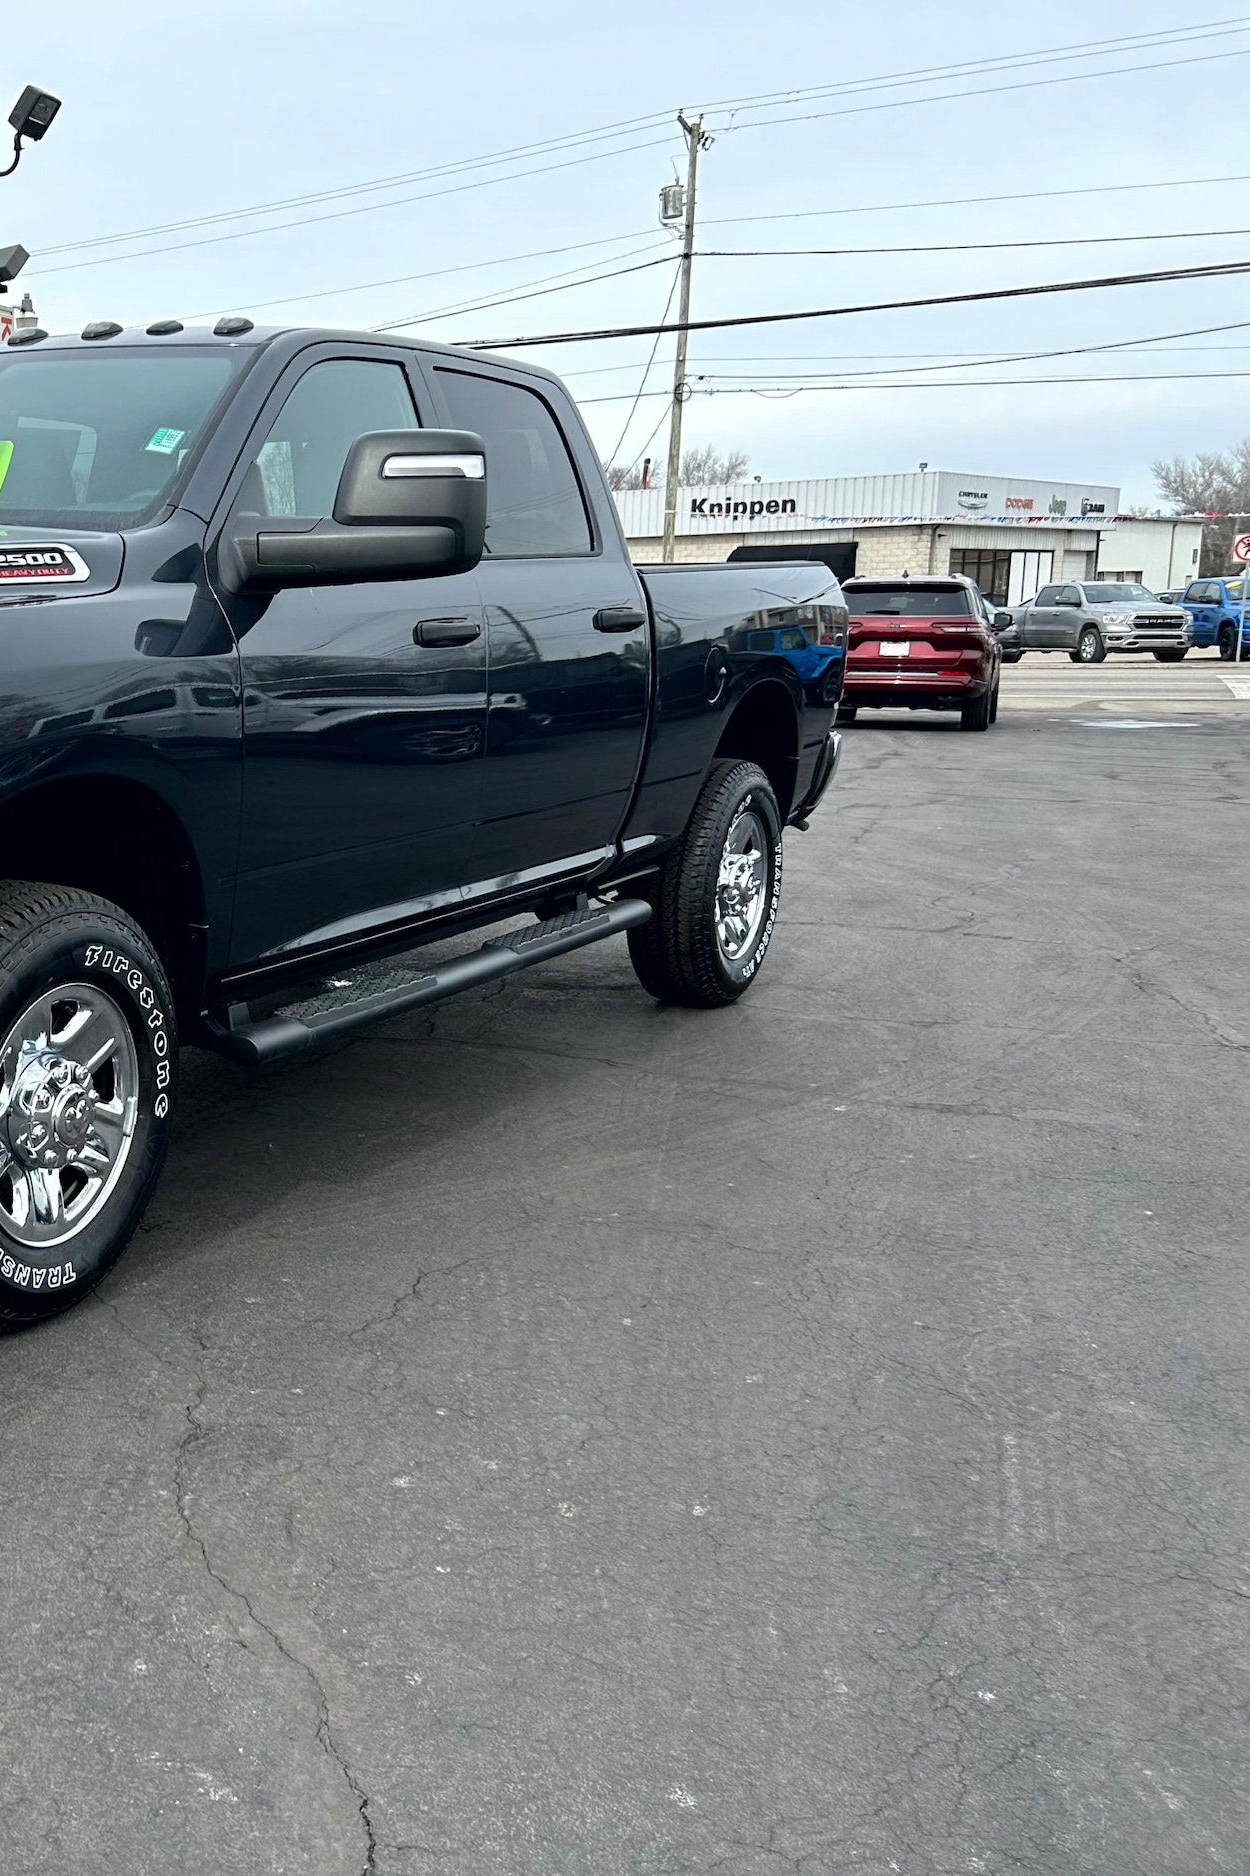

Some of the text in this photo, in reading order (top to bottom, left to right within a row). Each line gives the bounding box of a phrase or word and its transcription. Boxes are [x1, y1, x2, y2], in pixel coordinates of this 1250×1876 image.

[958, 490, 988, 500] CHRYSLER
[690, 497, 796, 521] Knippen
[1005, 497, 1034, 510] DODGE
[38, 567, 69, 576] DUTY
[85, 945, 170, 1118] Firestone
